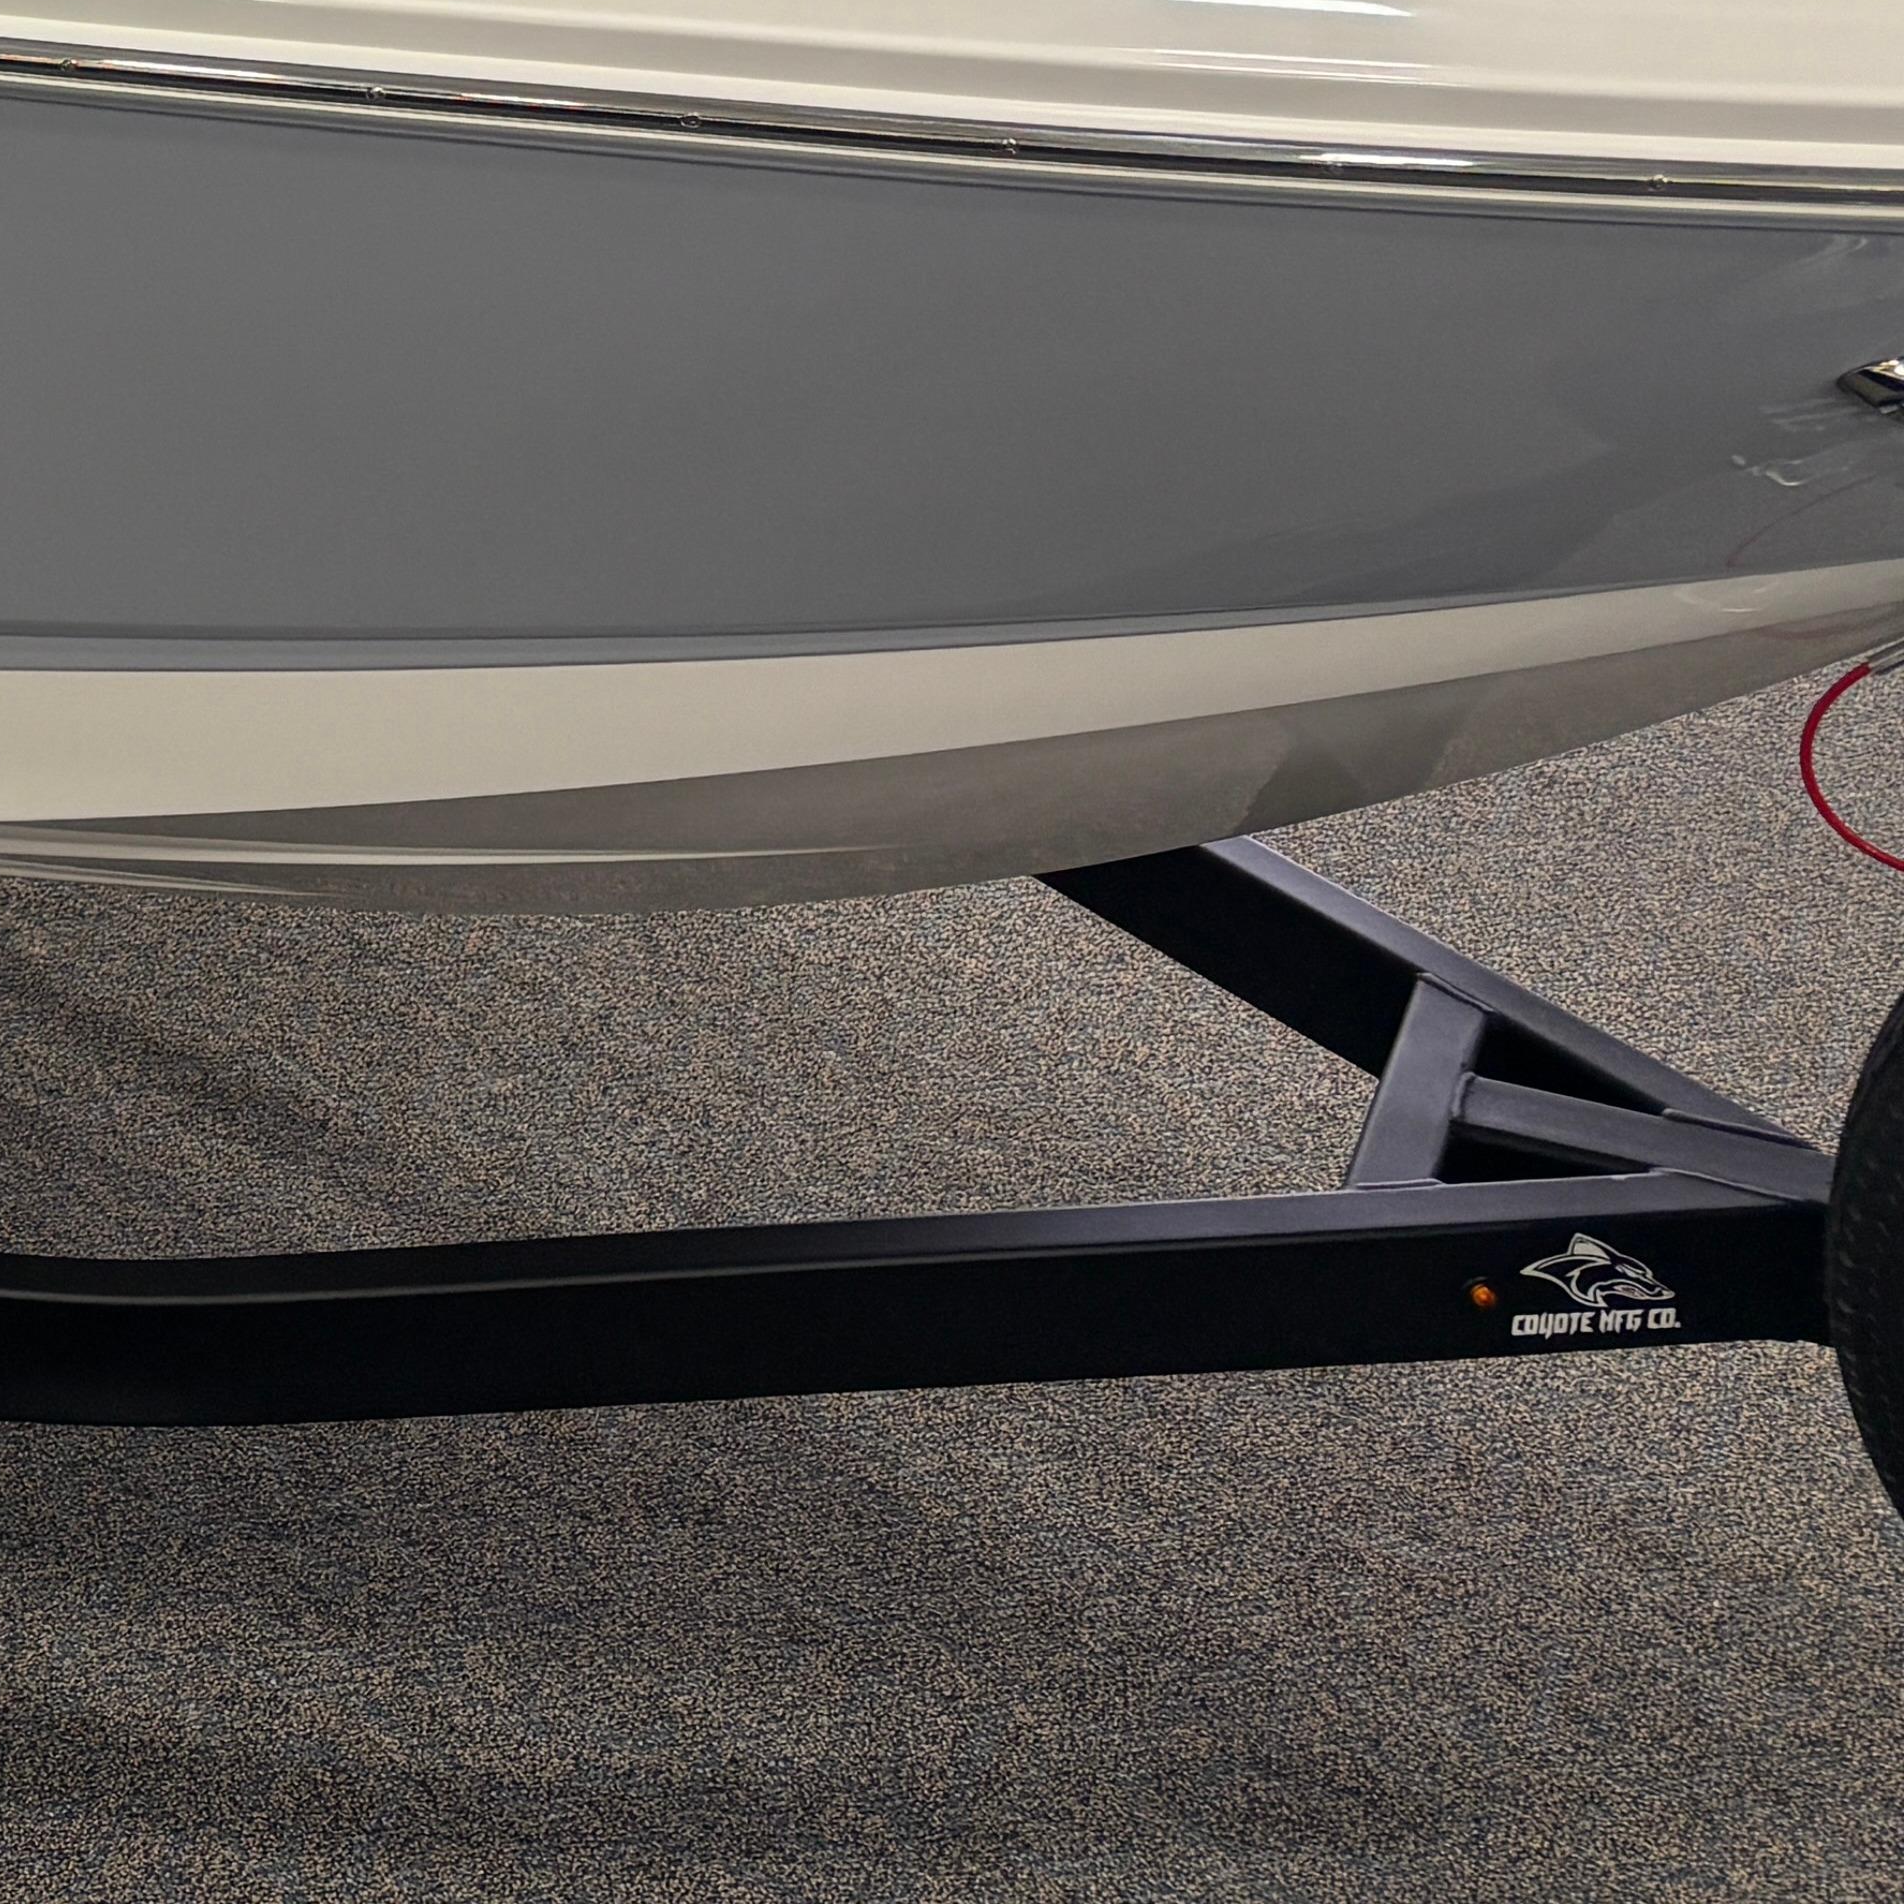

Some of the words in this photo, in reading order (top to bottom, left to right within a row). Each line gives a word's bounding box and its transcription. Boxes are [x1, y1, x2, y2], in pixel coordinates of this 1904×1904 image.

[1511, 1311, 1594, 1340] COYOTE
[1599, 1308, 1644, 1333] MFG
[1647, 1306, 1682, 1330] CO.
